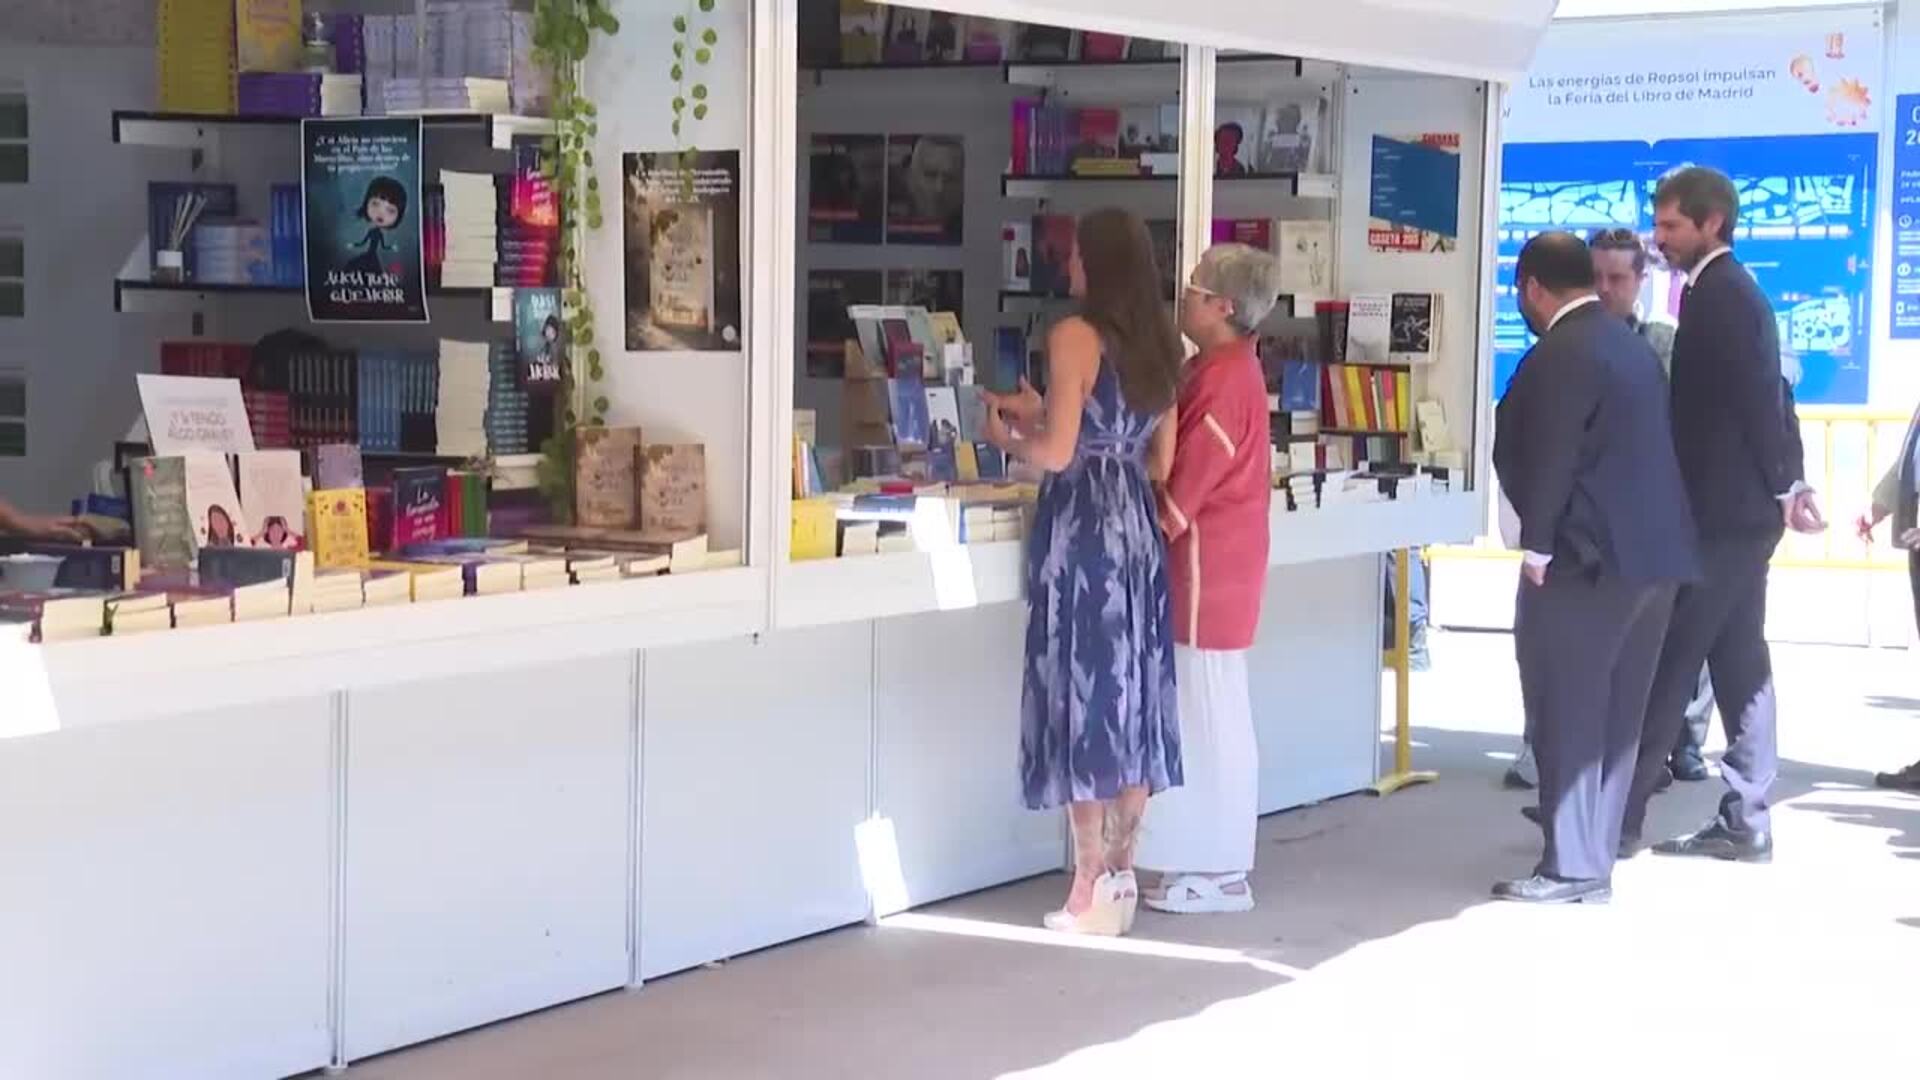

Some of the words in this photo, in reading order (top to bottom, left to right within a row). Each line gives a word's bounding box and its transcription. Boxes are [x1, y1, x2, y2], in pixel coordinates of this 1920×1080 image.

[1529, 75, 1554, 89] Las
[1624, 72, 1645, 85] de
[1647, 70, 1700, 87] Repsol
[1702, 67, 1776, 85] impulsan
[1548, 92, 1561, 105] la
[1564, 91, 1602, 105] Feria
[1605, 90, 1630, 104] del
[1632, 88, 1673, 103] Libro
[1674, 87, 1696, 102] de
[1697, 85, 1754, 101] Madrid
